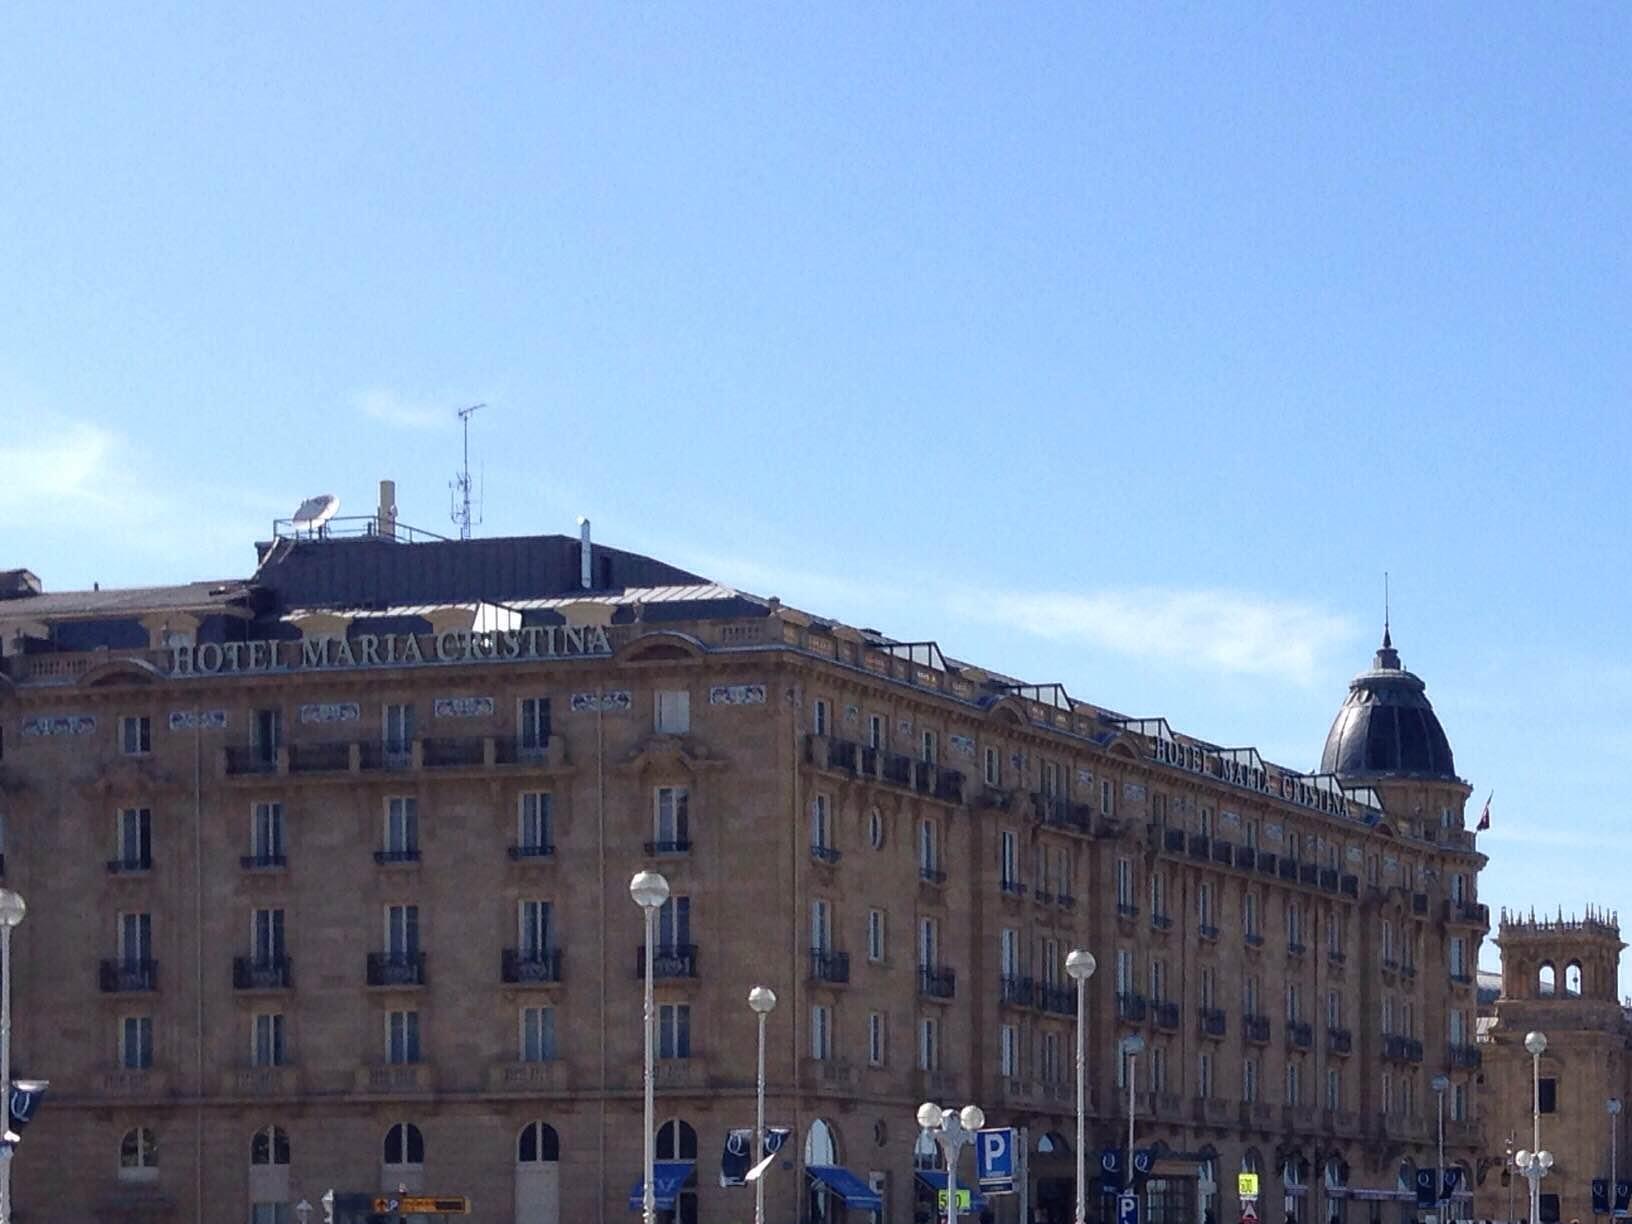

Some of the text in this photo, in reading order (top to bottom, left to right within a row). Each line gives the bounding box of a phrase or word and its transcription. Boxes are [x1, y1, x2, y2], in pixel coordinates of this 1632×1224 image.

[172, 623, 613, 676] HOTEL MARIA CRISTINA
[1156, 735, 1351, 818] HOTEL MARIA CRISTINA
[985, 1133, 1006, 1171] P
[1121, 1199, 1135, 1218] P
